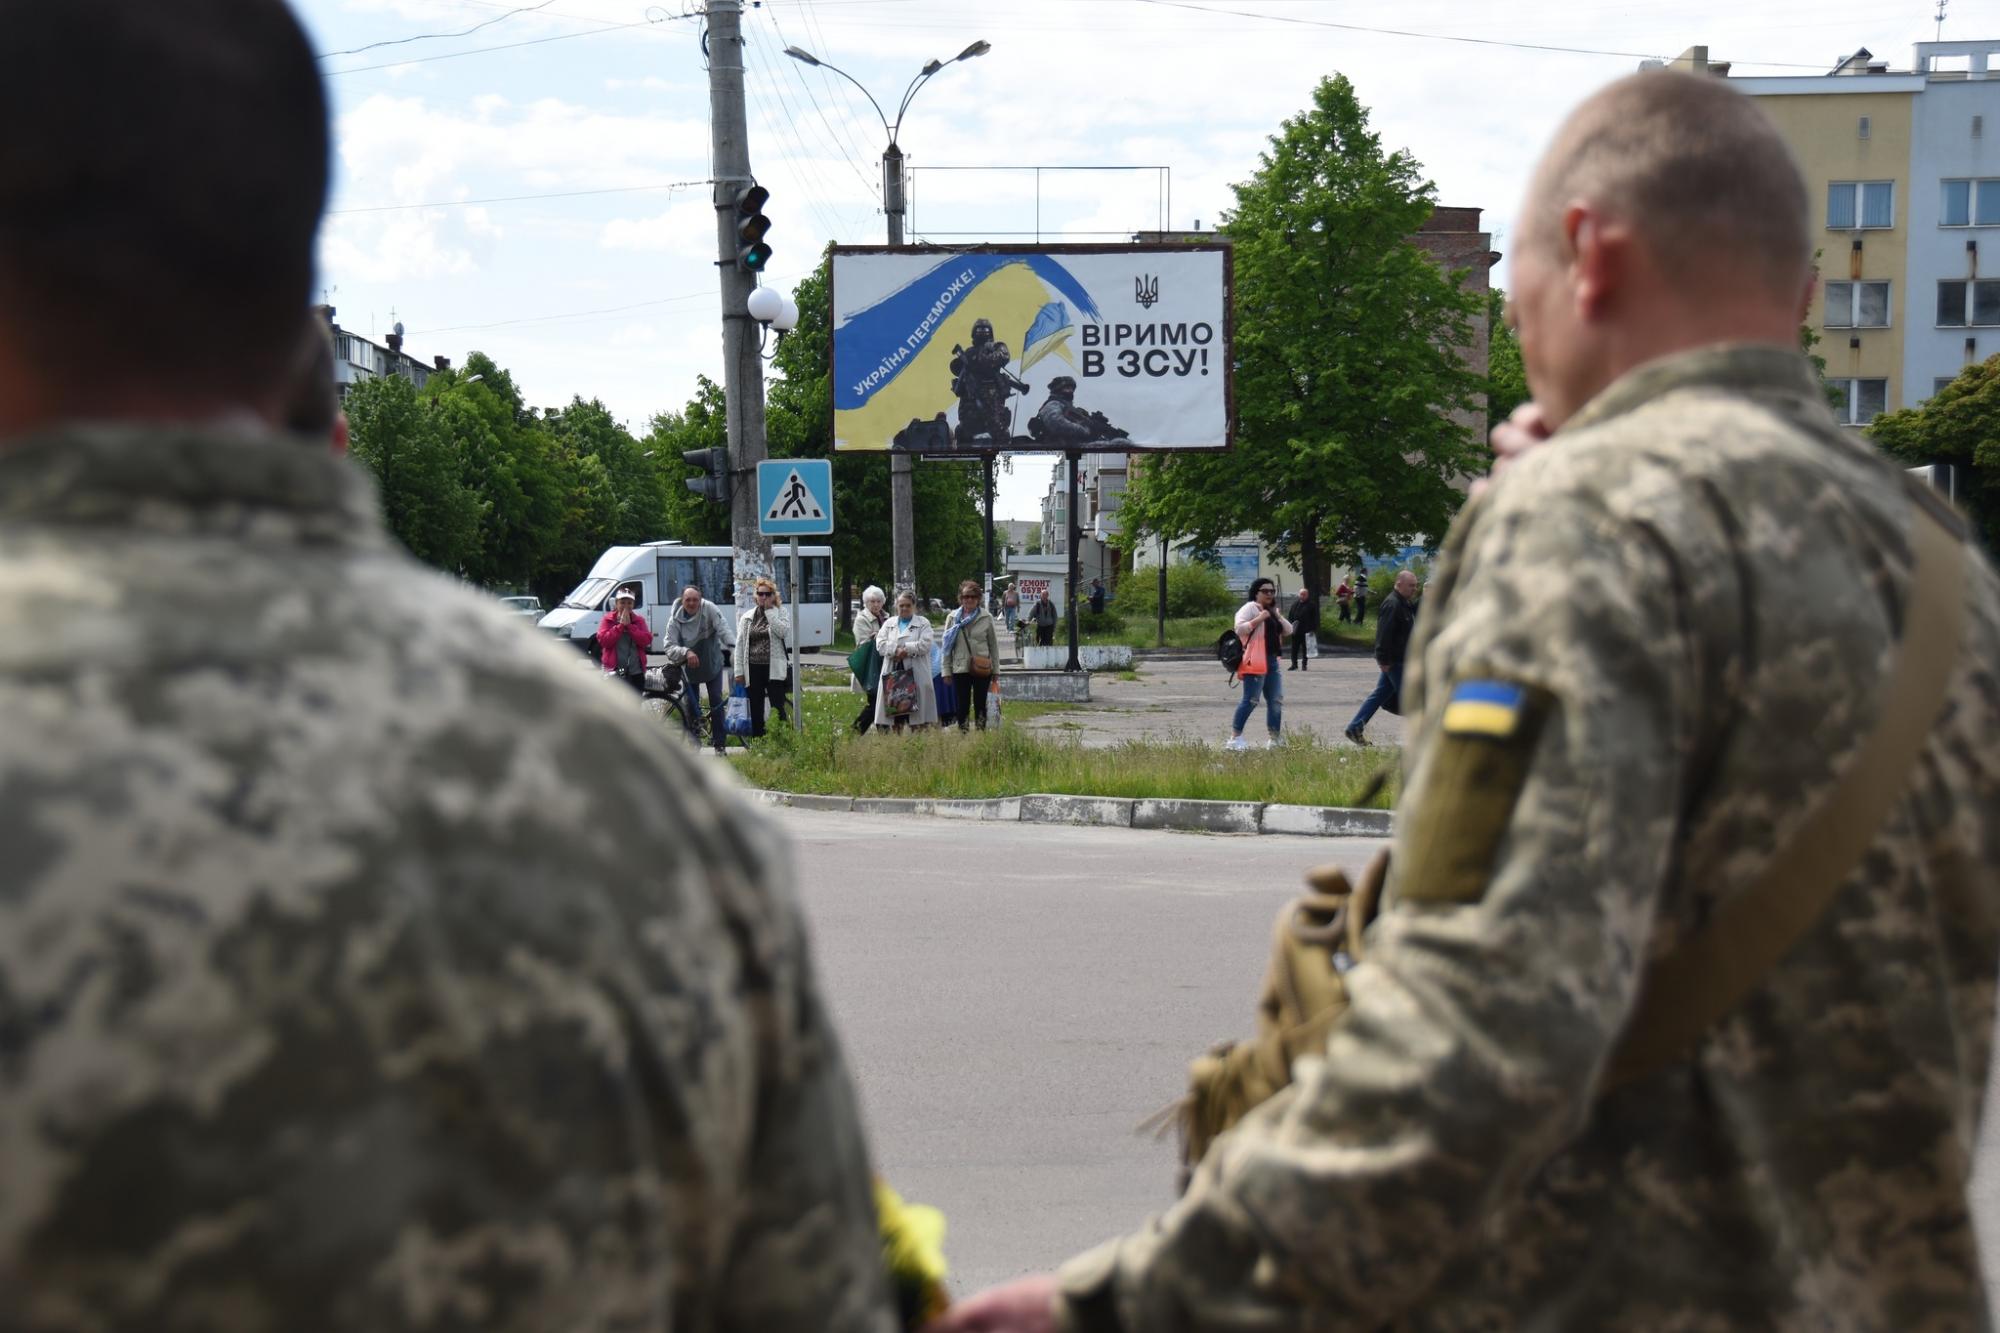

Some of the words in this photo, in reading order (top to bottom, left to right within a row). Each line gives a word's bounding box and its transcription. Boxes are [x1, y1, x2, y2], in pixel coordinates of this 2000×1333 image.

[853, 347, 910, 395] УКРАЇНА
[906, 269, 976, 348] ПЕРЕМОЖЕ!
[1082, 322, 1213, 346] ВІРИМО
[1082, 350, 1105, 377] В
[1117, 348, 1208, 377] ЗСУ!
[1019, 579, 1051, 587] РЕМОНТ
